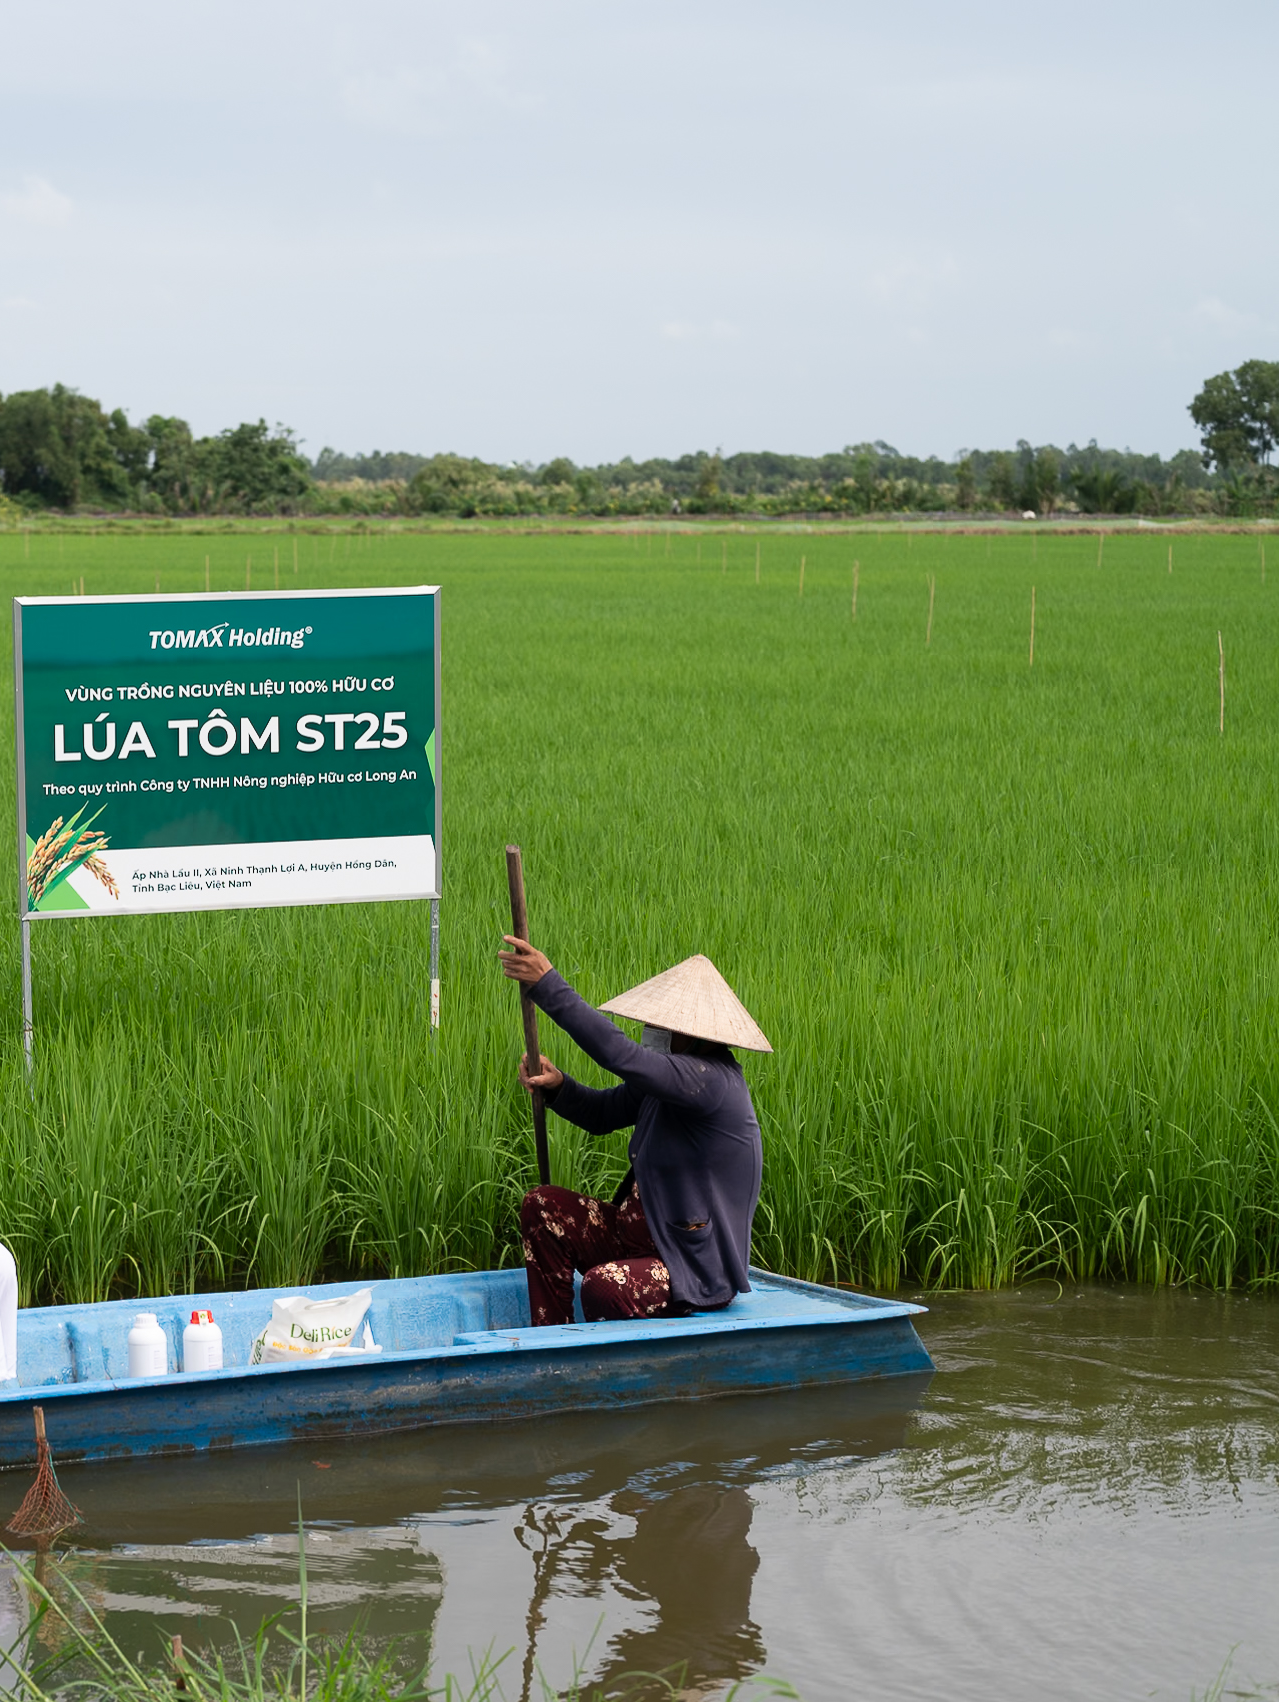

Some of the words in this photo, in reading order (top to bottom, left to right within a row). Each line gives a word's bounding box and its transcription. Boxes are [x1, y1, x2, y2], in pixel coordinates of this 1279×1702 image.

[148, 622, 229, 650] TOMAX
[65, 686, 112, 701] VÙNG
[117, 682, 174, 700] TRỒNG
[179, 681, 245, 697] NGUYÊN
[251, 679, 284, 697] LIỆU
[289, 680, 328, 693] 100%
[333, 676, 366, 692] HỮU
[371, 676, 394, 691] CƠ
[55, 713, 156, 761] LÚA
[168, 709, 279, 756] TÔM
[297, 712, 407, 752] ST25
[43, 784, 75, 795] Theo
[79, 784, 103, 796] quy
[106, 781, 136, 792] trình
[141, 779, 173, 792] Công
[177, 780, 190, 792] ty
[193, 777, 229, 788] TNHH
[234, 776, 267, 788] Nông
[271, 773, 315, 787] nghiệp
[319, 772, 344, 783] Hữu
[347, 772, 362, 782] cơ
[366, 771, 396, 782] Long
[400, 770, 416, 780] An
[149, 869, 169, 879] Nhà
[220, 865, 243, 875] Ninh
[245, 864, 277, 875] Thạnh
[297, 863, 307, 872] A,
[310, 861, 342, 872] Huyện
[157, 883, 176, 893] Bạc
[179, 881, 202, 890] Liêu,
[205, 879, 225, 890] Việt
[228, 879, 251, 888] Nam
